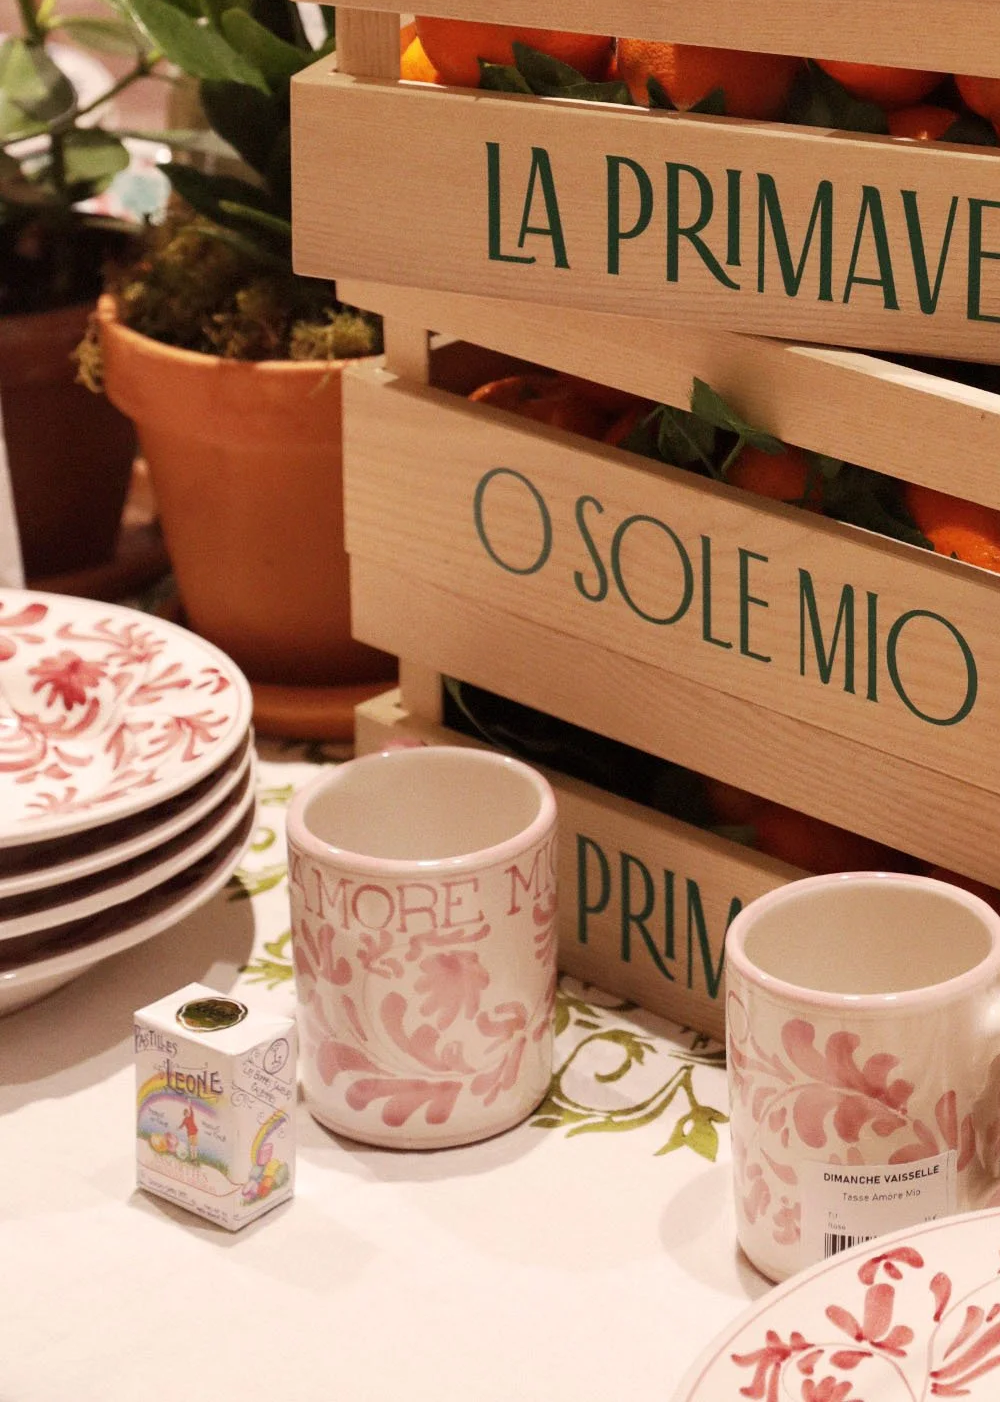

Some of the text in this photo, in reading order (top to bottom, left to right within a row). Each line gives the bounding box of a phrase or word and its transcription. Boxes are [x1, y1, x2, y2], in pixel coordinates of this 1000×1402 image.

[485, 141, 570, 269] LA
[473, 467, 979, 727] O SOLE MIO
[288, 852, 486, 933] AMORE
[575, 832, 743, 1000] PRIM
[164, 1058, 224, 1098] LEONE
[823, 1165, 940, 1185] DIMANCHE VAISSELLE
[843, 1192, 869, 1202] Tasse
[871, 1192, 904, 1202] Amore
